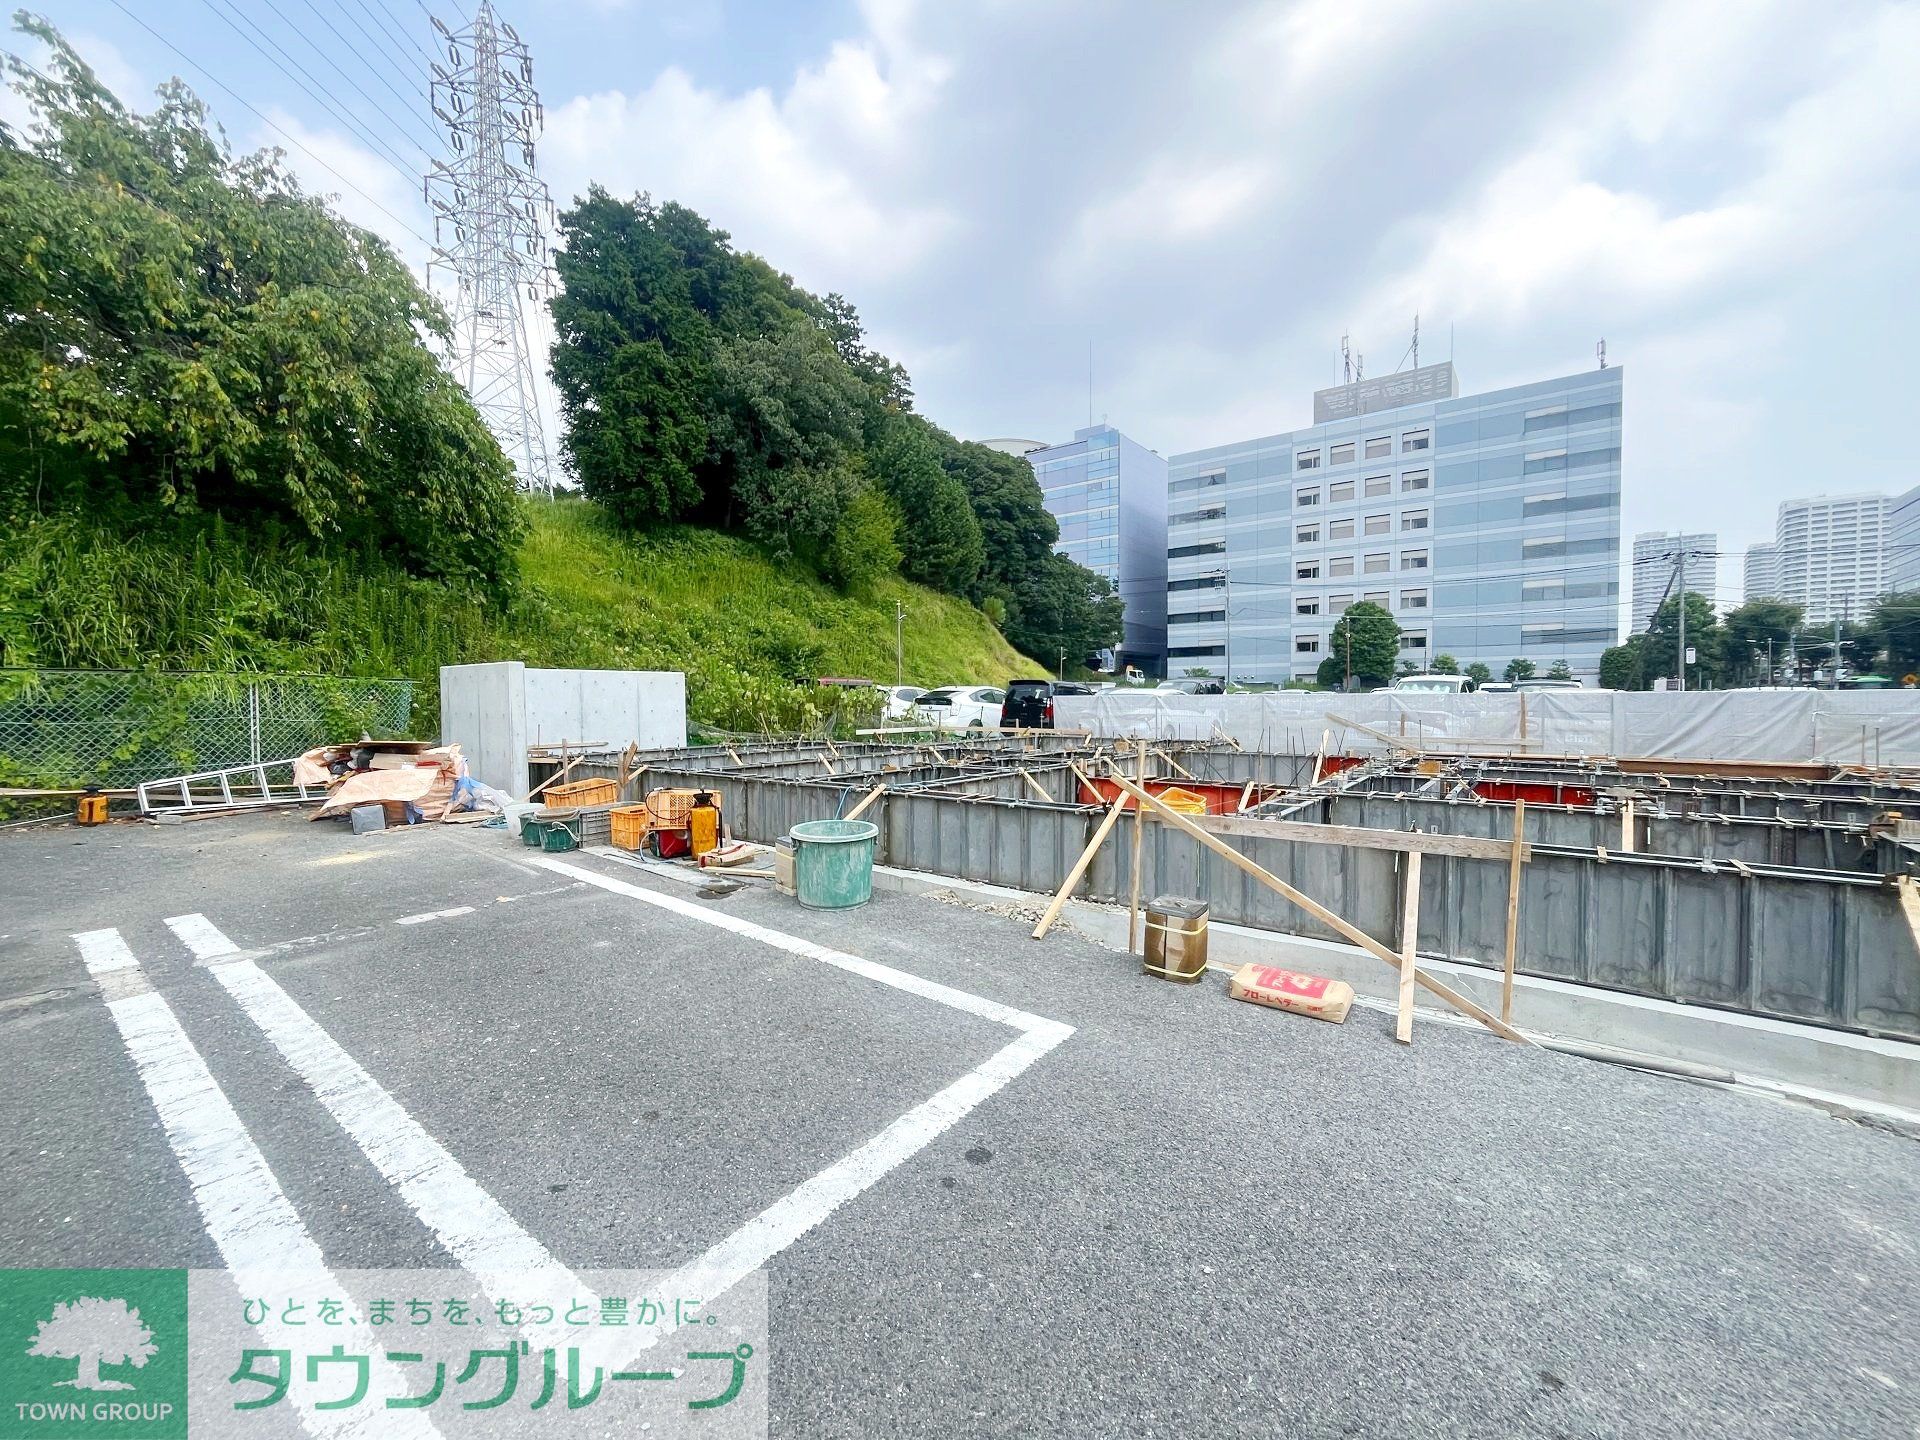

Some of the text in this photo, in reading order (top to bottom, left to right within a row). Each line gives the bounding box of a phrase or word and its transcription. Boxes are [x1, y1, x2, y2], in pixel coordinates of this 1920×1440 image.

[1243, 989, 1299, 1007] フローレベラー
